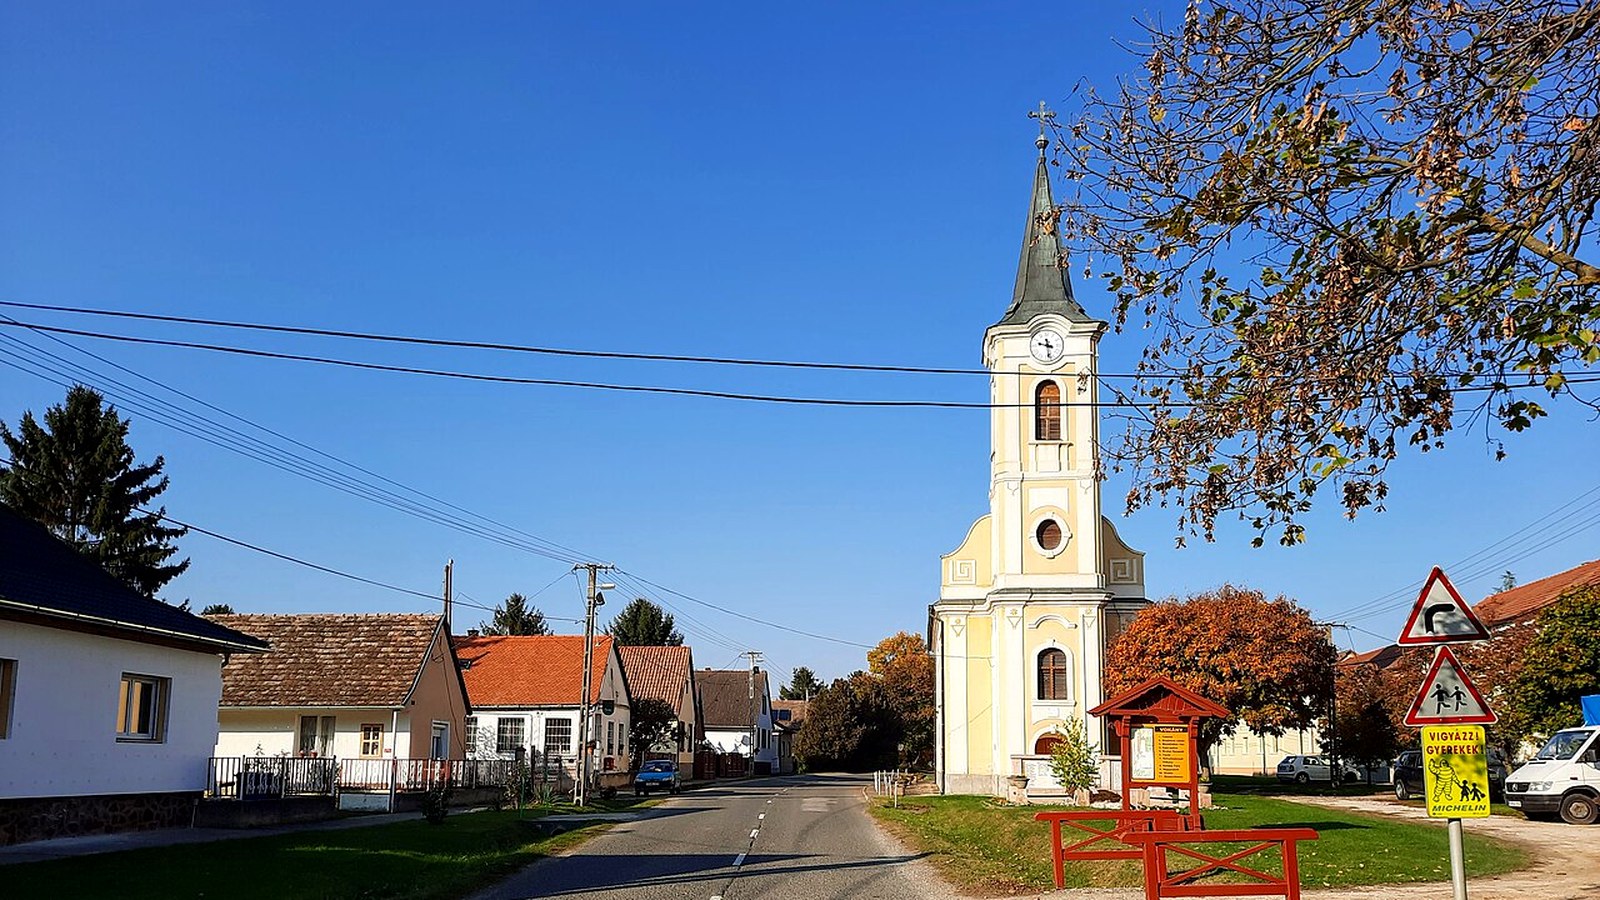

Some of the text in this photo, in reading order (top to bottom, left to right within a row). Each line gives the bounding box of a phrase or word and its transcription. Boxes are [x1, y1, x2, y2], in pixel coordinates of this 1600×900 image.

[1429, 730, 1479, 741] VIGYÁZZ!
[1426, 744, 1484, 755] GYEREKEK!
[1432, 804, 1486, 812] MICHELIN
